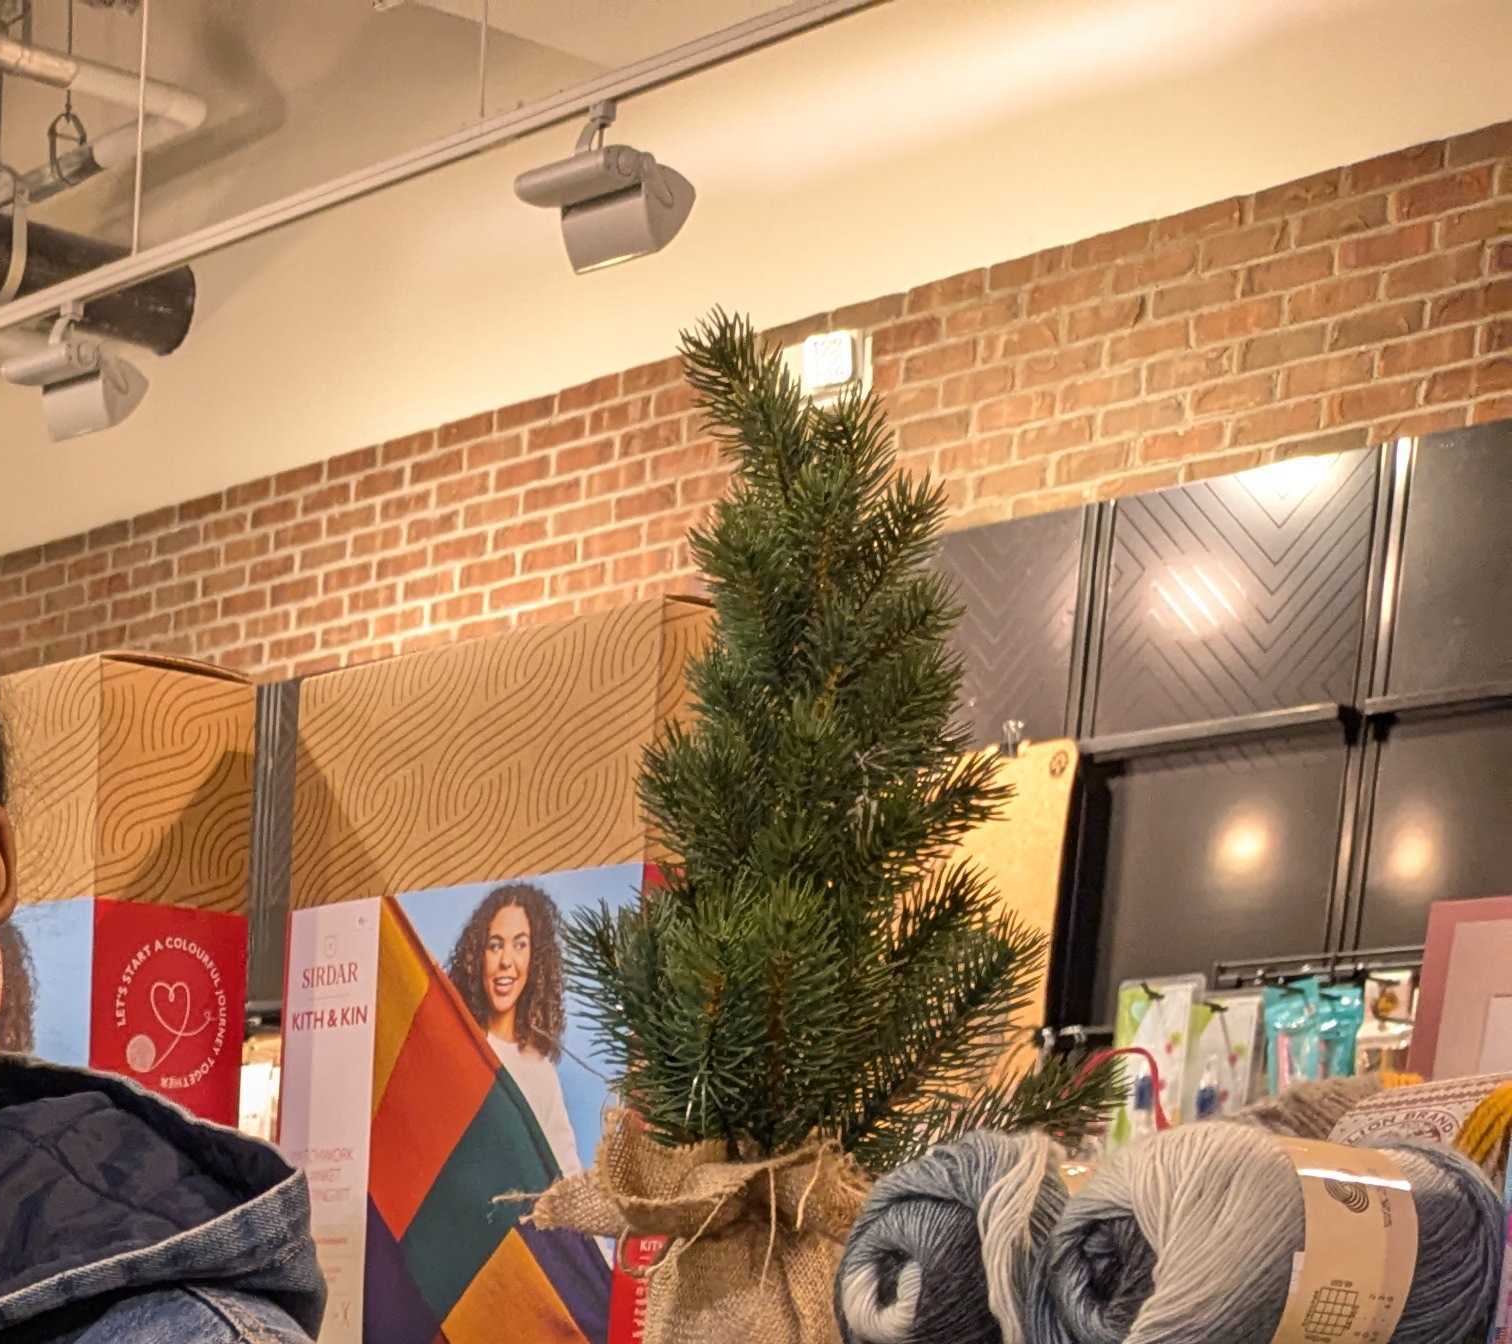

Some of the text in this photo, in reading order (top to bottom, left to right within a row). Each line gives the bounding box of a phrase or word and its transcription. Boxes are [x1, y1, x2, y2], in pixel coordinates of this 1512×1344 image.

[301, 961, 359, 989] SIRDAR
[115, 937, 227, 1089] LET'S START A COLOURFUL JOURNEY TOGETHER
[291, 1005, 368, 1031] KITH & KIN
[1346, 1110, 1454, 1145] LION BRAND
